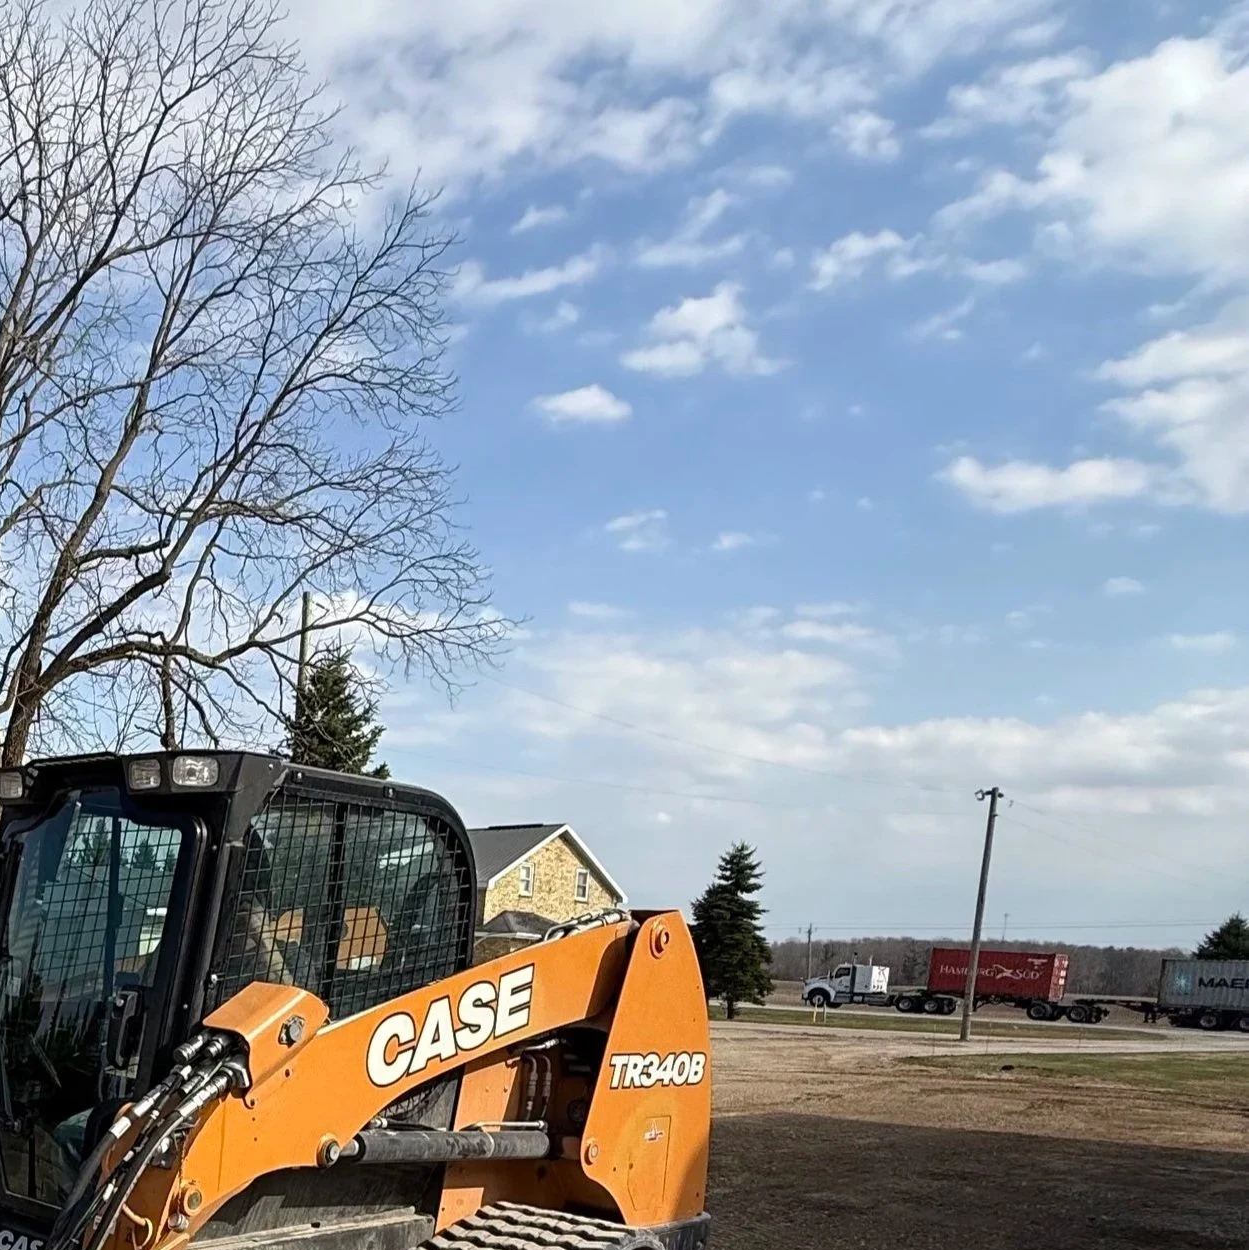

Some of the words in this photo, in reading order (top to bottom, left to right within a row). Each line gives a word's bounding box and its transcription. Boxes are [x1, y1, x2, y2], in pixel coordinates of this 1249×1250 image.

[939, 964, 994, 977] HAMRG
[1198, 977, 1249, 989] MAE
[366, 963, 535, 1088] CASE
[609, 1051, 707, 1089] TR340B
